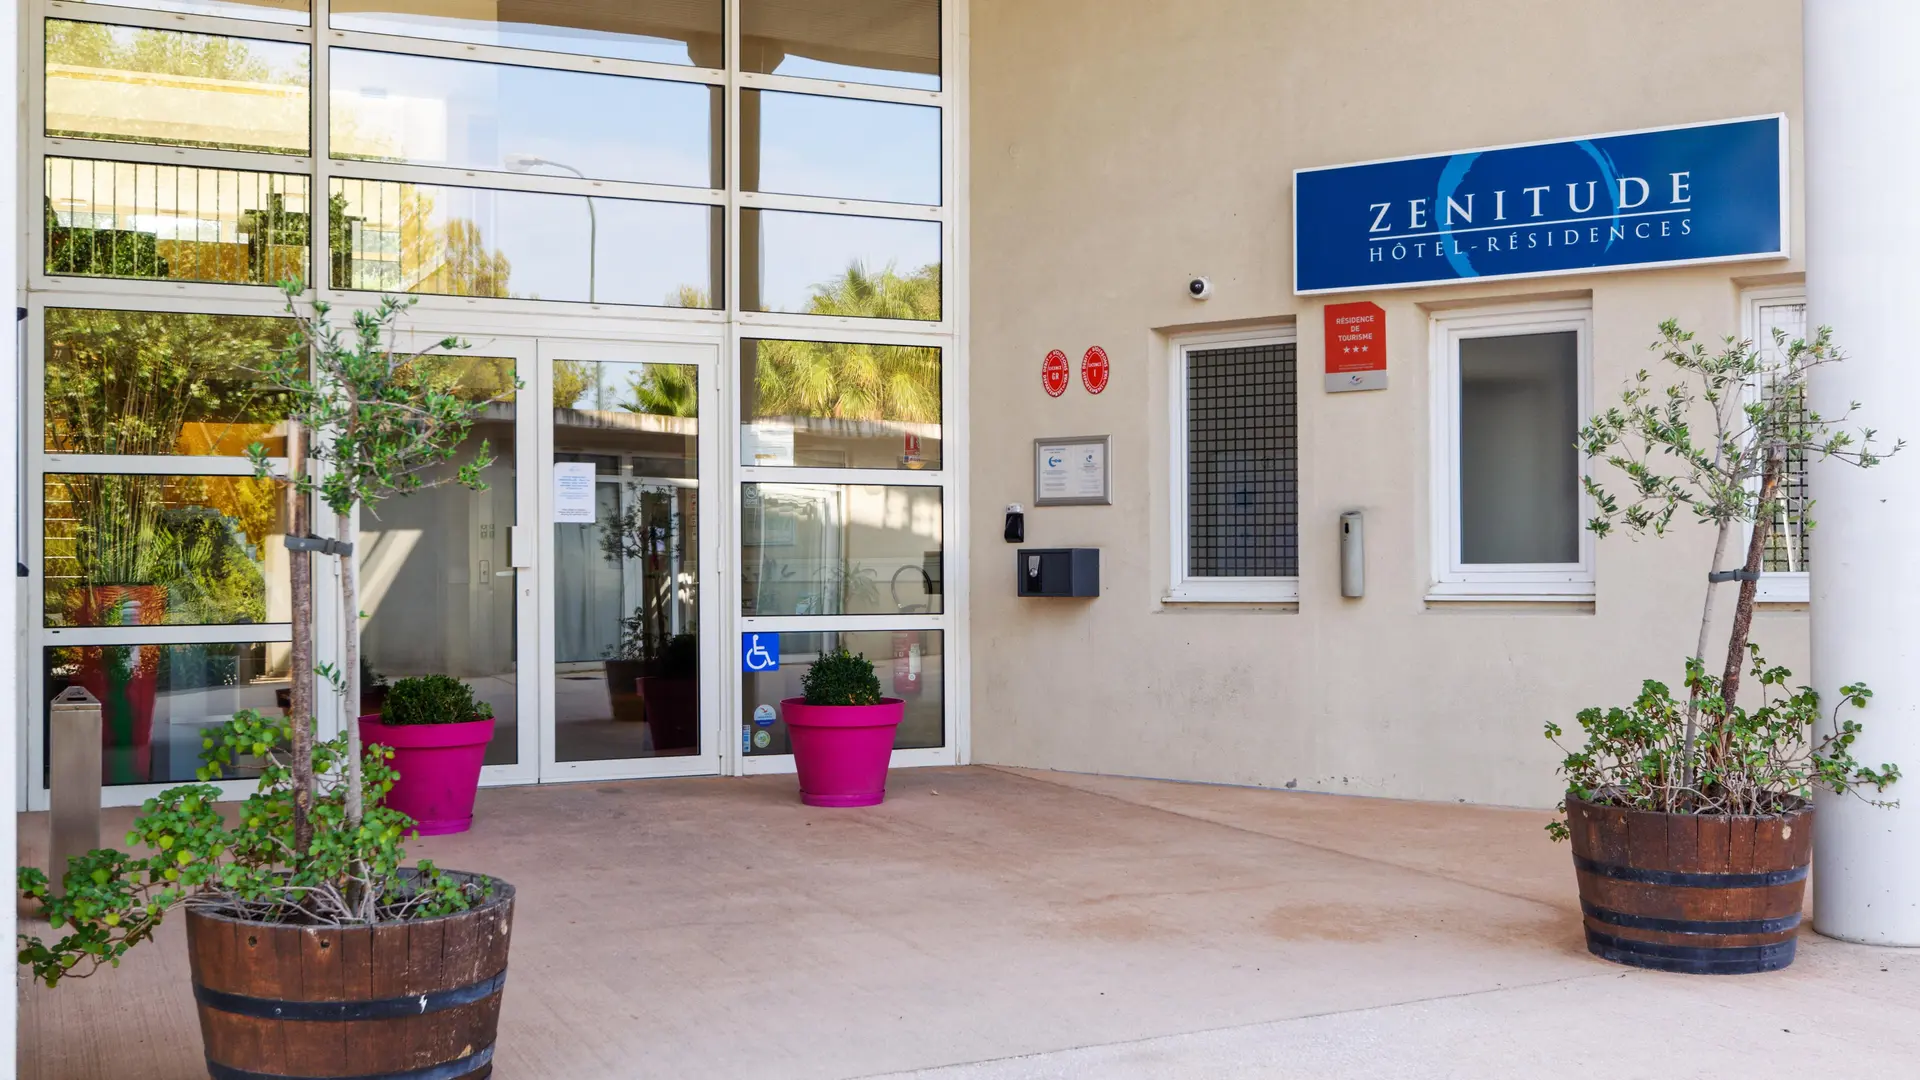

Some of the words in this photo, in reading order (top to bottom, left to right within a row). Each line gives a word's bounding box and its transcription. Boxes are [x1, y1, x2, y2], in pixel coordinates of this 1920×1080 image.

[1368, 171, 1692, 233] ZENITUDE
[1369, 219, 1692, 262] HÔTEL-RÉSIDENCES
[1335, 315, 1375, 325] RÉSIDENCE
[1337, 332, 1373, 342] TOURISME
